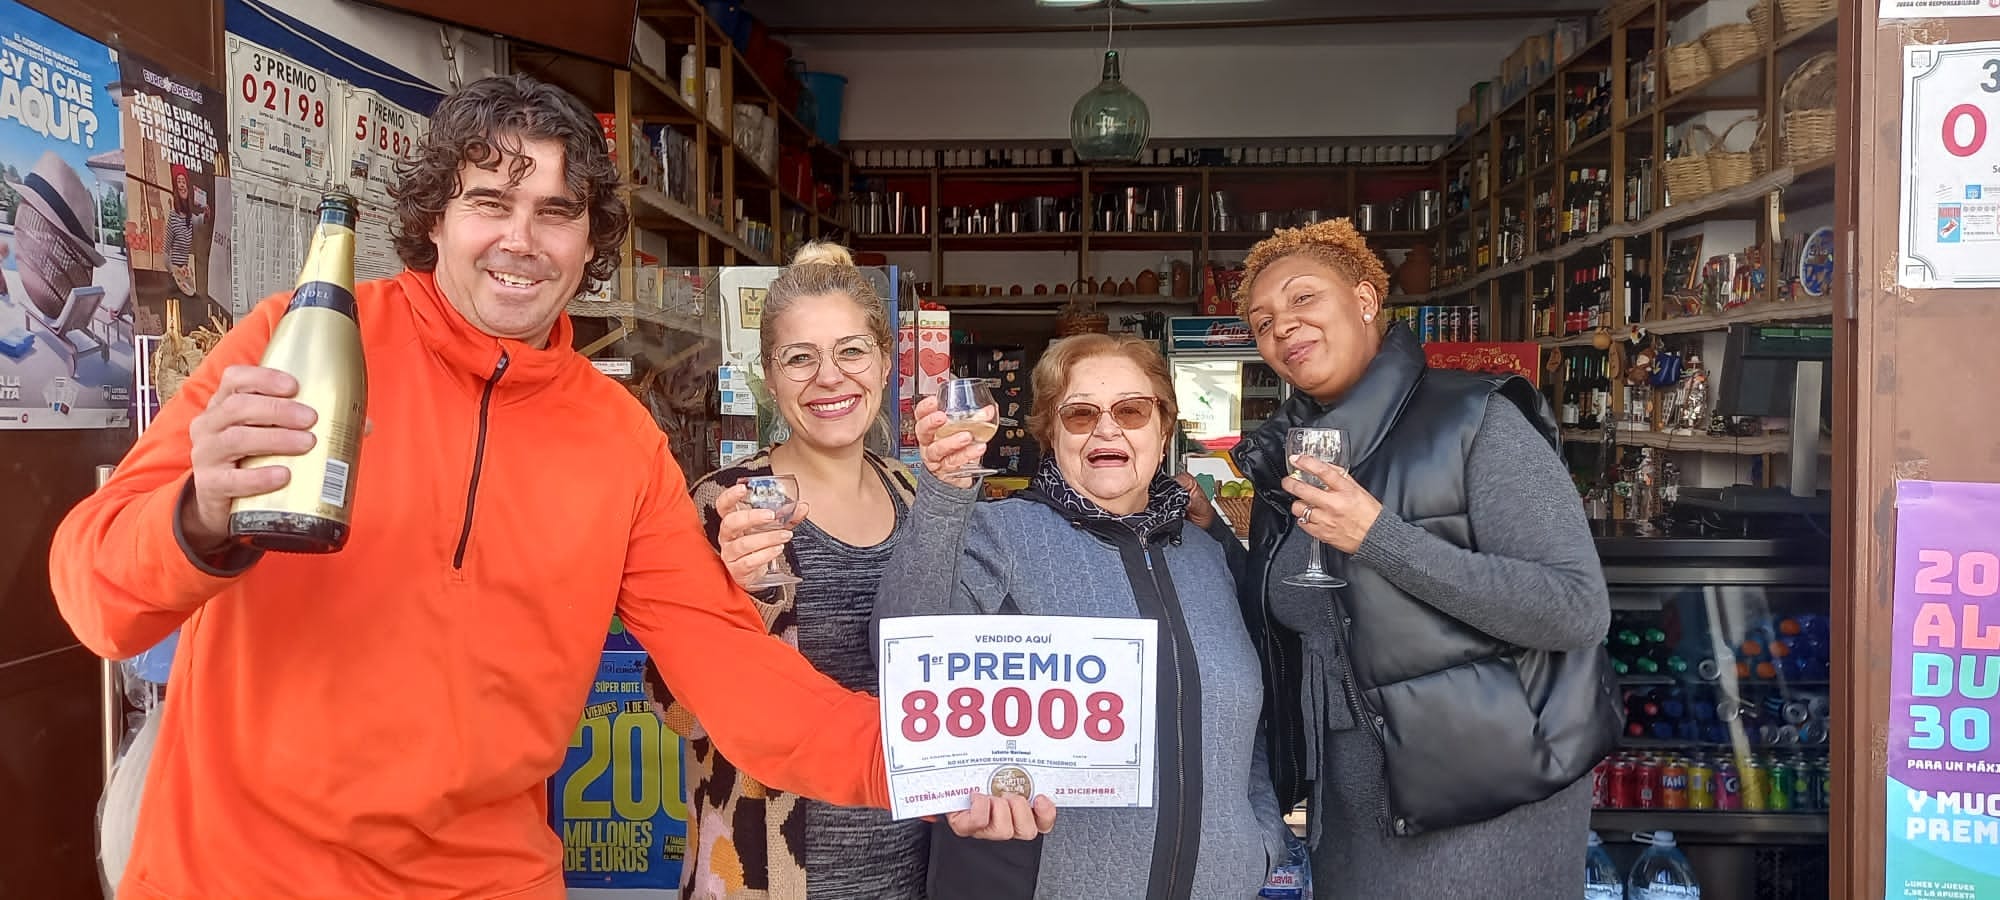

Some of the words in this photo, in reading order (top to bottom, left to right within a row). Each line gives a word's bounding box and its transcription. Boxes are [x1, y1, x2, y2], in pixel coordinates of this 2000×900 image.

[0, 49, 24, 80] ¿Y
[29, 61, 49, 91] SI
[52, 71, 93, 109] CAE
[267, 58, 317, 93] PREMIO
[0, 77, 98, 149] AQUÍ?
[242, 73, 324, 128] 02198
[131, 104, 153, 124] MES
[154, 112, 181, 136] PARA
[172, 105, 203, 130] EUROS
[204, 119, 214, 135] AL
[375, 102, 405, 130] PREMIO
[1941, 103, 1987, 157] 0
[139, 122, 153, 140] TU
[187, 141, 200, 158] DE
[200, 148, 215, 165] SER
[355, 114, 411, 160] 51882
[160, 146, 203, 174] PINTORA
[1914, 549, 2000, 598] 20
[975, 635, 1023, 643] VENDIDO
[1026, 633, 1052, 644] AQUÍ
[1912, 602, 2000, 650] AL
[918, 653, 943, 683] 1er
[948, 653, 1107, 684] PREMIO
[1911, 651, 2000, 700] DU
[595, 680, 620, 693] SÚPER
[621, 682, 640, 693] BOTE
[584, 701, 618, 719] VIERNES
[625, 701, 631, 713] 1
[633, 701, 643, 713] DE
[901, 687, 1125, 742] 88008
[1908, 704, 1990, 752] 30
[1907, 759, 1943, 770] PARA
[1945, 760, 1964, 771] UN
[905, 791, 937, 803] LOTERÍA
[945, 786, 980, 798] NAVIDAD
[1907, 789, 1927, 813] Y
[563, 820, 653, 848] MILLONES
[1906, 816, 1999, 845] PREM
[564, 847, 588, 872] DE
[591, 847, 649, 873] EUROS
[1904, 880, 1933, 888] LUNES
[1941, 882, 1976, 891] JUEVES
[1924, 889, 1936, 897] LA
[1937, 890, 1975, 900] APUESTA
